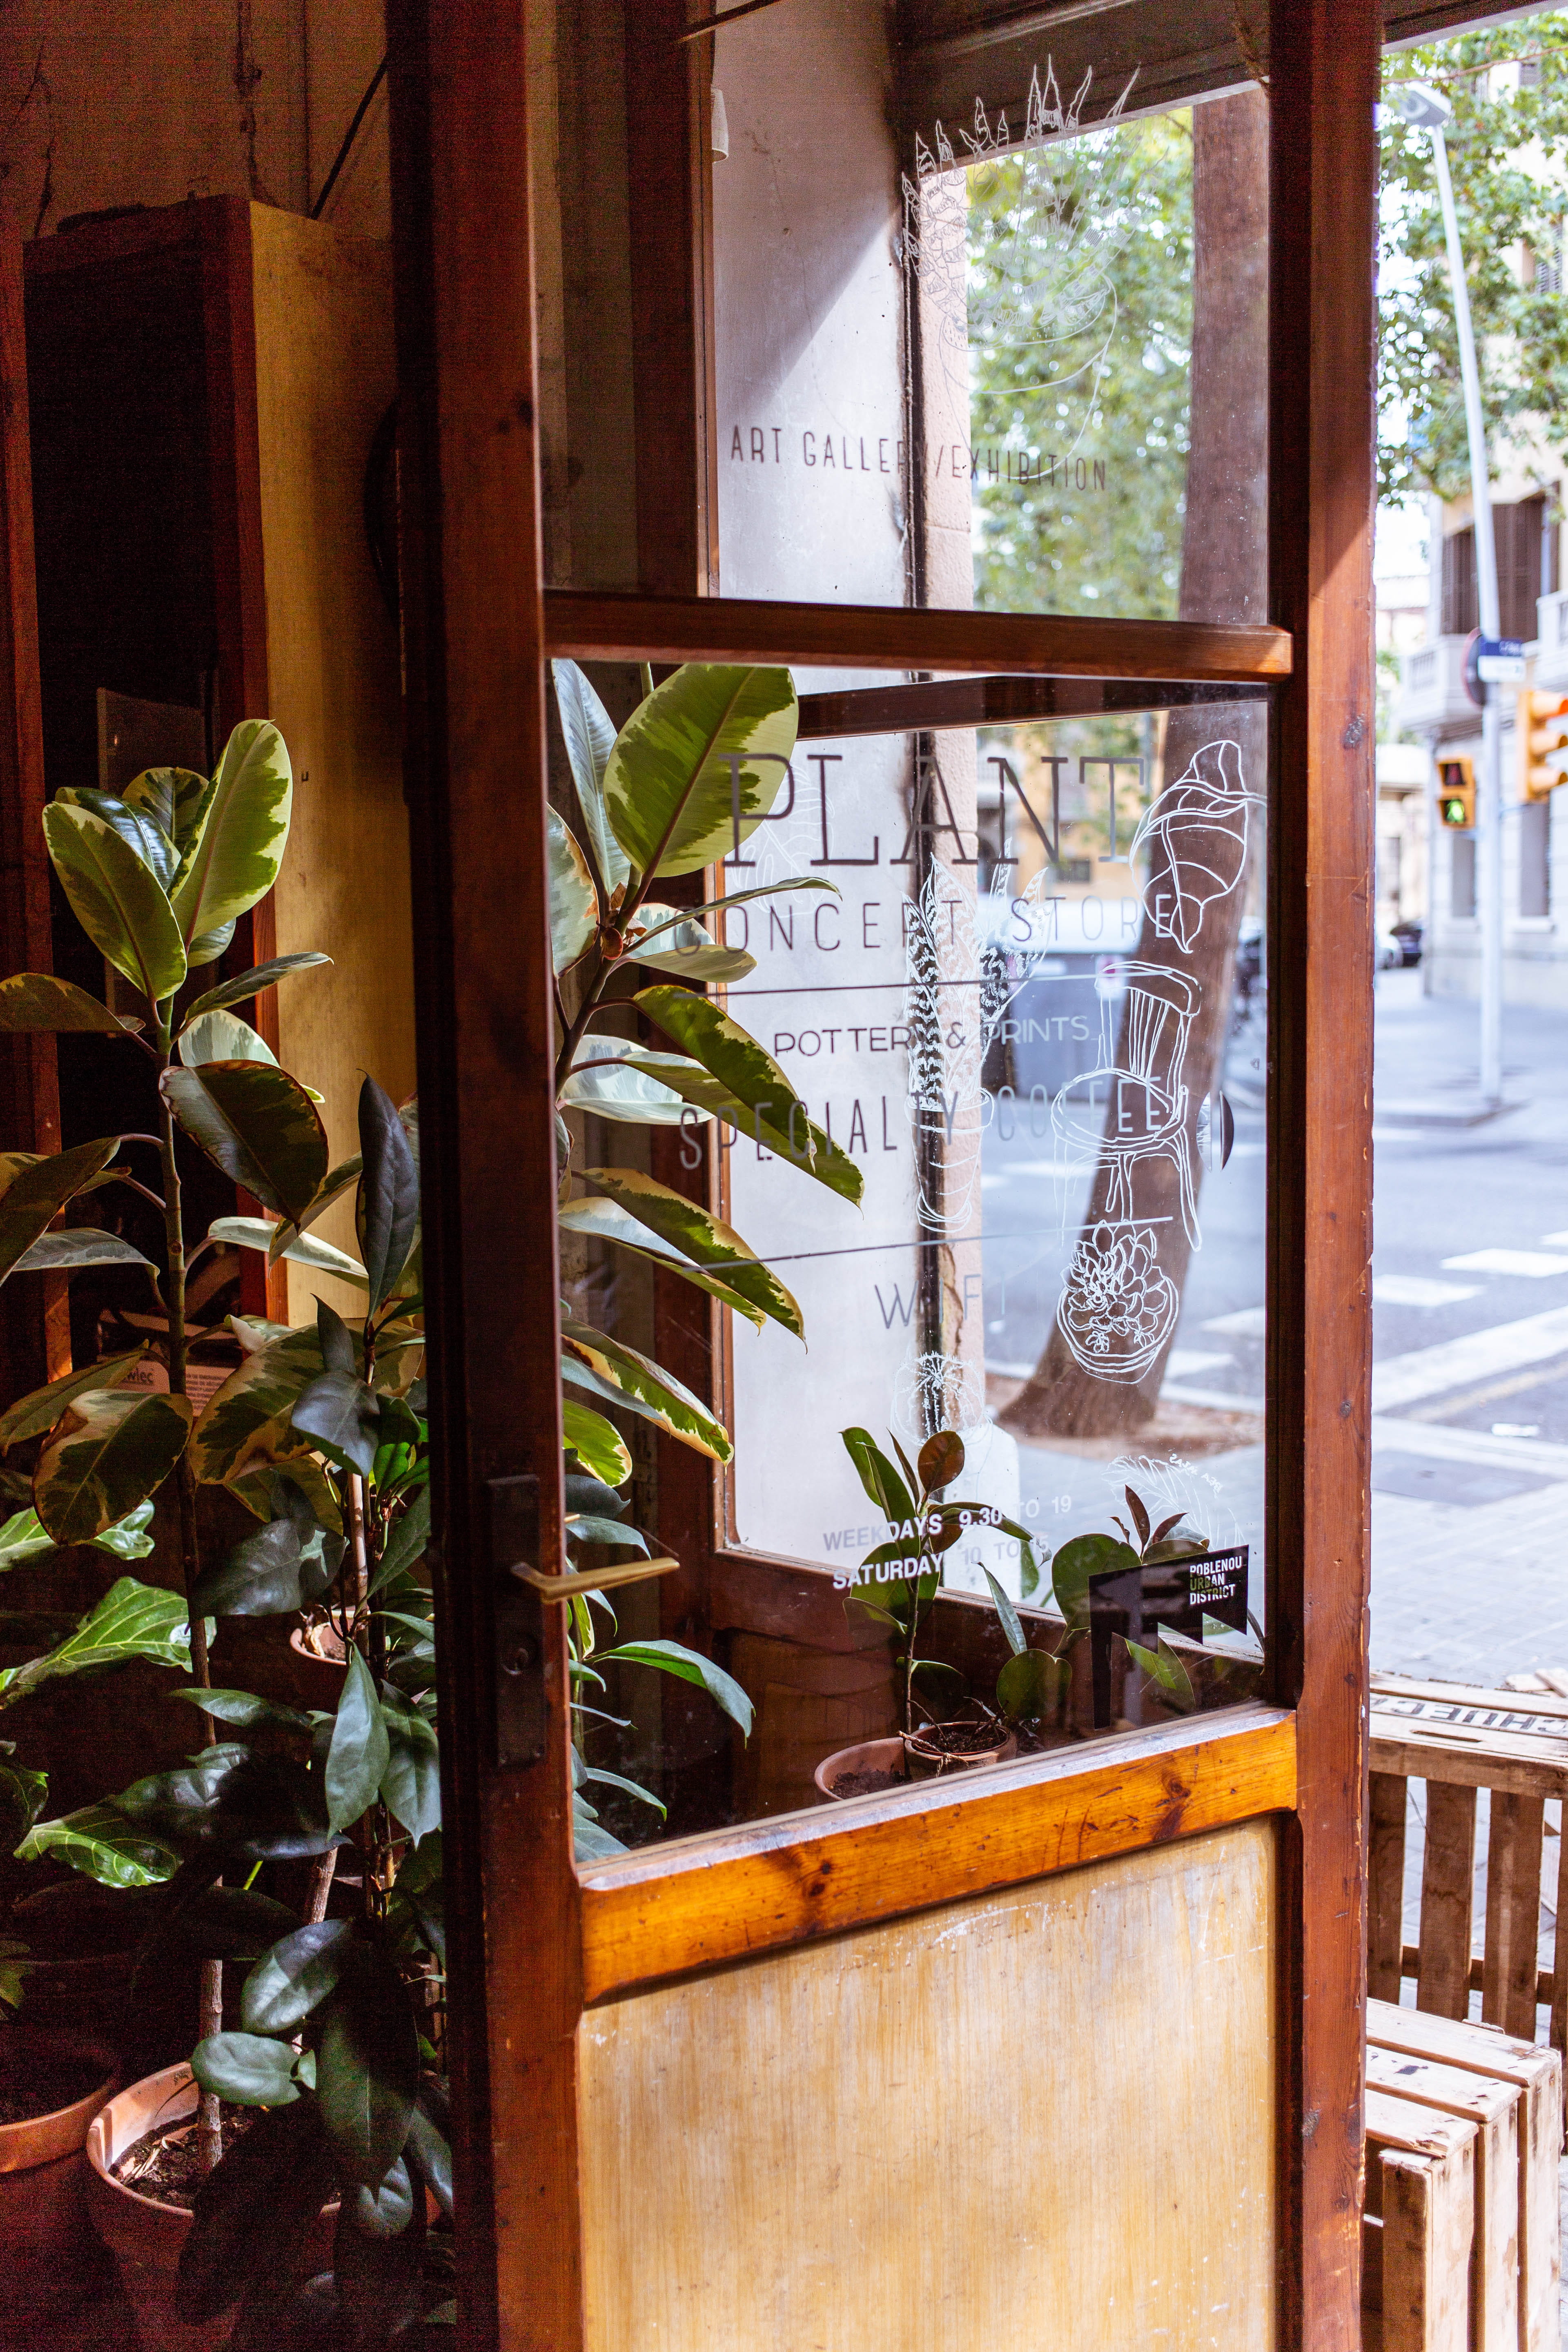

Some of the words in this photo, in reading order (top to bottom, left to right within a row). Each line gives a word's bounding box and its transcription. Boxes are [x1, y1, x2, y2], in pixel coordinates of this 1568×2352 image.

[731, 425, 781, 464] ART
[719, 753, 1144, 868] PLANT
[675, 900, 962, 956] CONCEPT
[1011, 894, 1172, 943] STORE
[946, 1022, 966, 1049] &
[980, 1016, 1089, 1045] PRINTS
[680, 1091, 959, 1169] SPECIALTY
[998, 1076, 1162, 1141] COFFEE
[823, 1513, 943, 1550] WEEKDAYS
[958, 1507, 1002, 1530] 9.30
[1051, 1495, 1072, 1514] 19
[833, 1552, 943, 1589] SATURDAY
[962, 1546, 981, 1564] 10
[993, 1540, 1020, 1560] TO
[1189, 1556, 1242, 1578] POBLENOU
[1189, 1573, 1225, 1591] URBAN
[1189, 1584, 1236, 1605] DISTRICT
